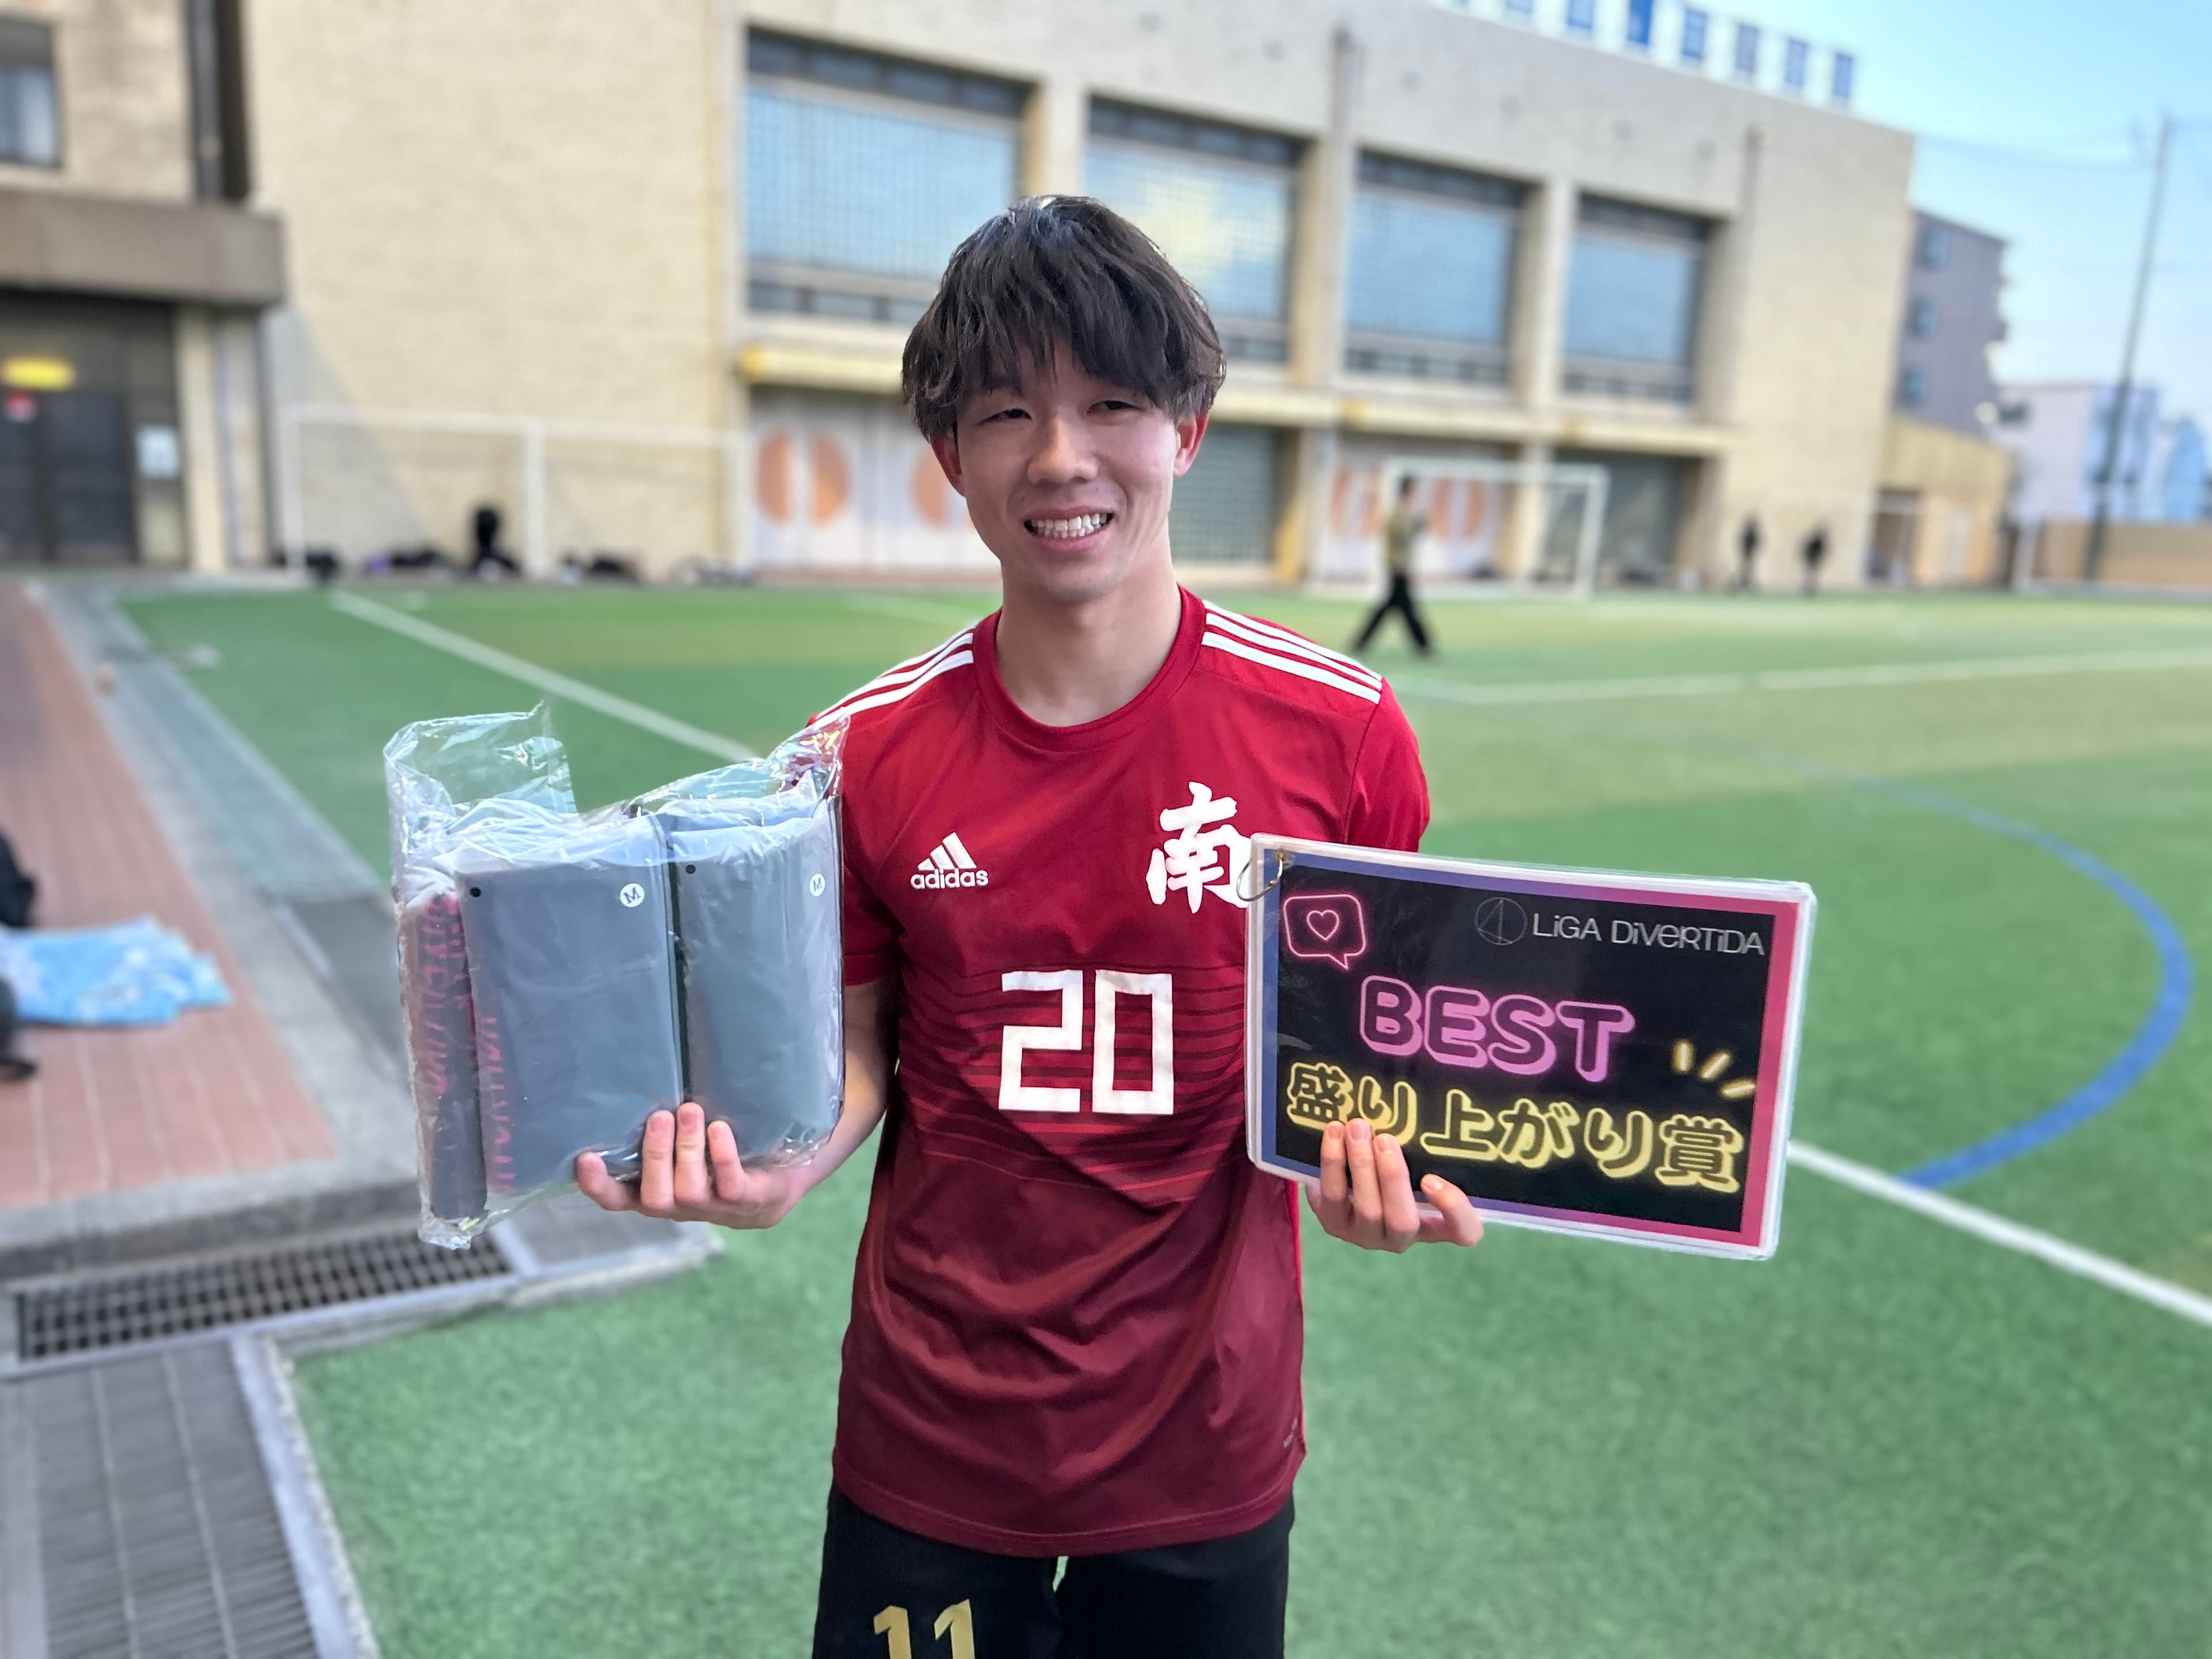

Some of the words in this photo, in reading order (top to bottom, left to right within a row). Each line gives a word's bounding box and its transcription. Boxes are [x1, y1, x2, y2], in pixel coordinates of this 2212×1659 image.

[910, 868, 989, 889] adidas
[1146, 781, 1251, 914] 南
[999, 969, 1174, 1115] 20
[1359, 975, 1635, 1084] BEST
[1286, 1061, 1744, 1193] 盛り上がり賞
[873, 1599, 975, 1659] 11
